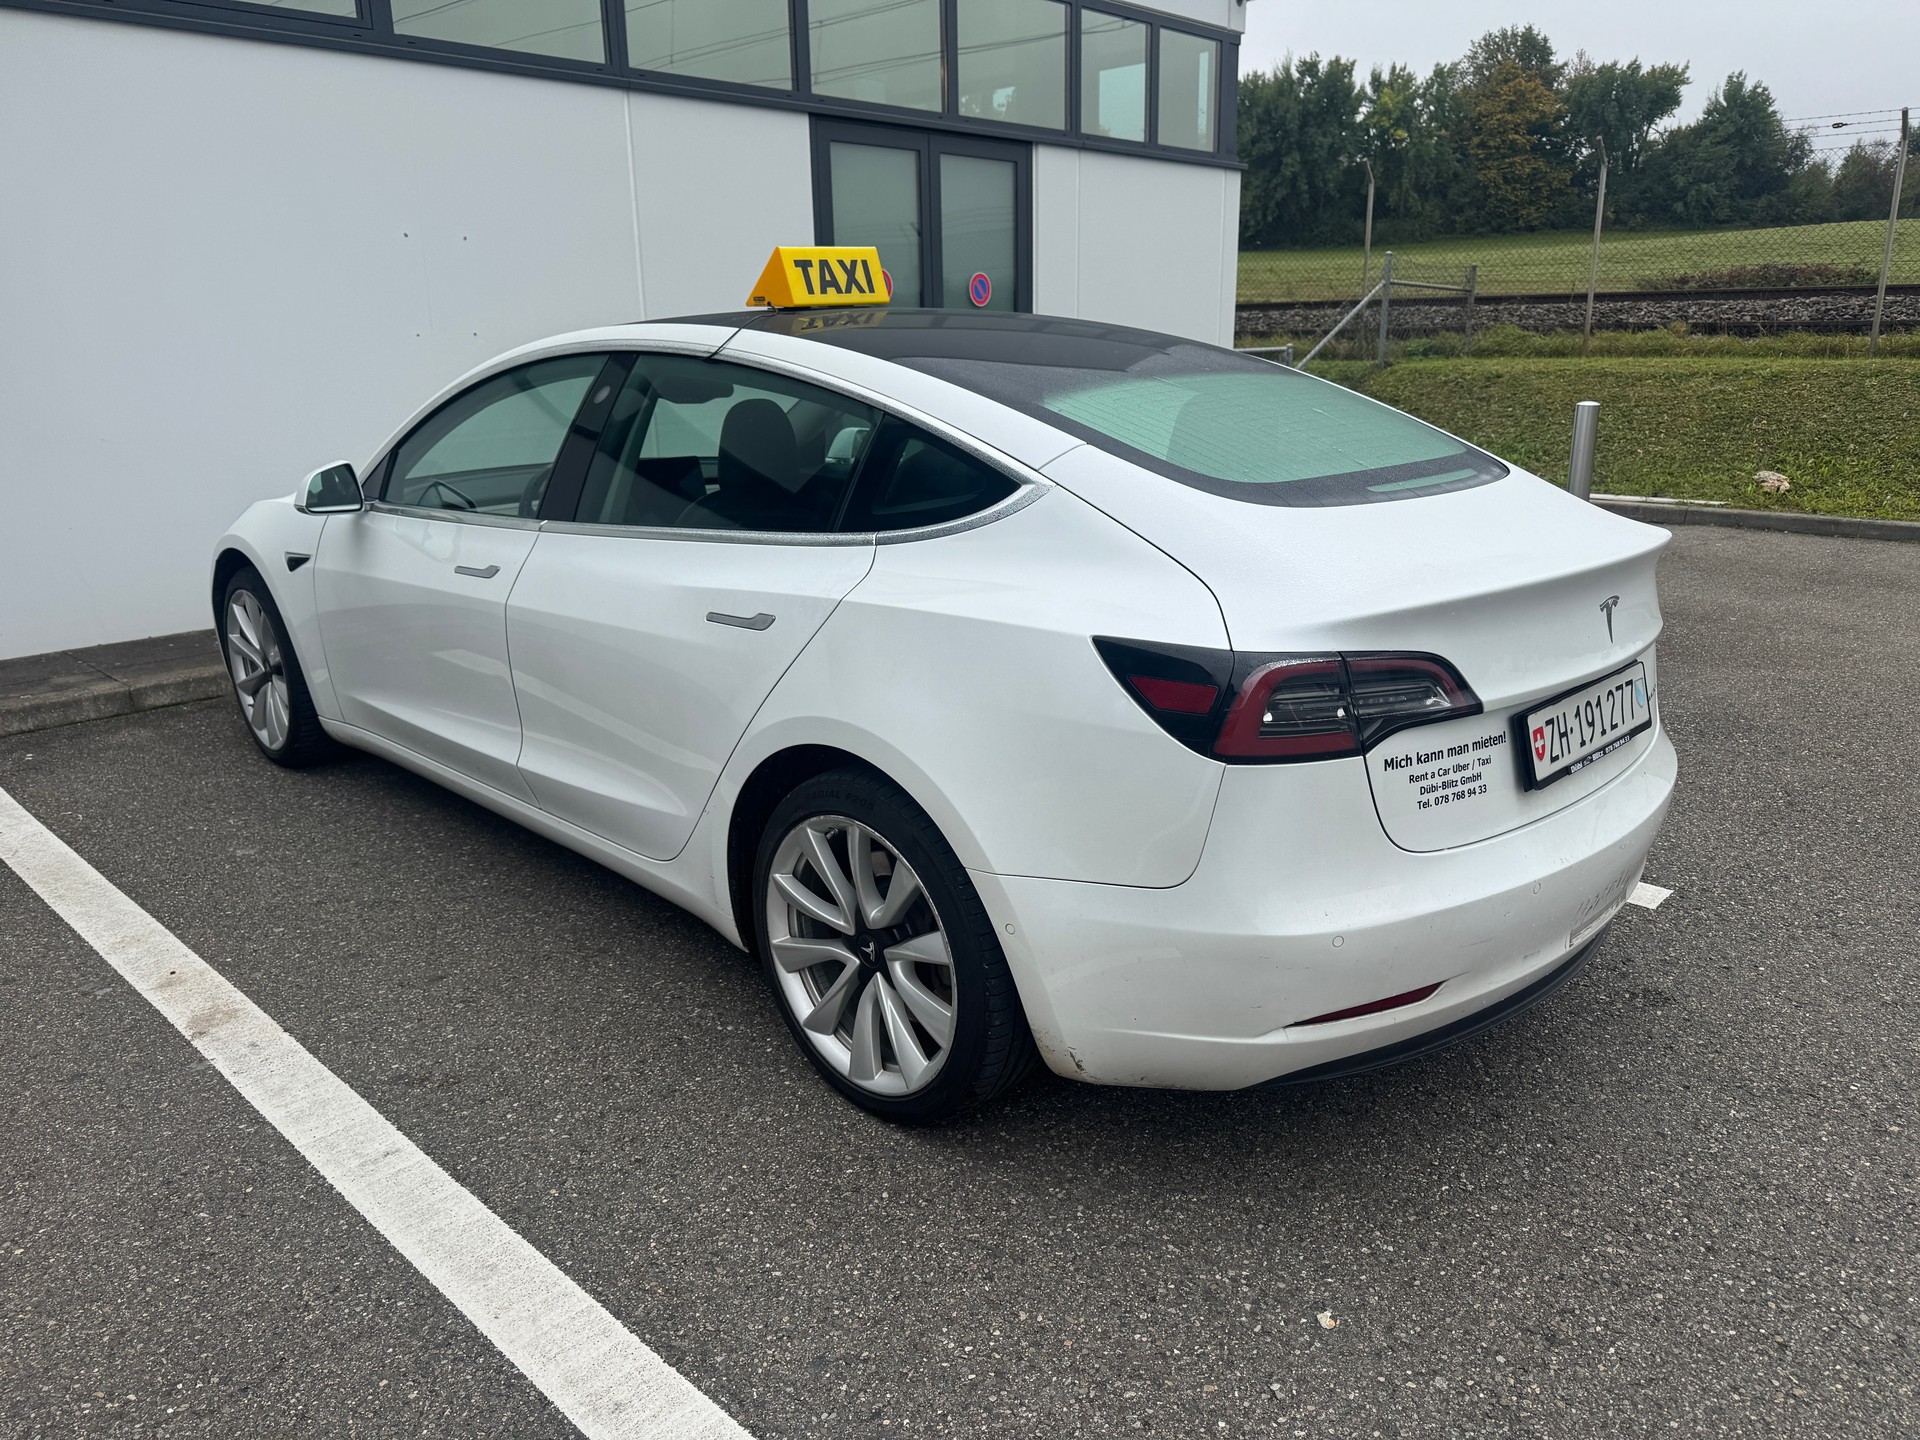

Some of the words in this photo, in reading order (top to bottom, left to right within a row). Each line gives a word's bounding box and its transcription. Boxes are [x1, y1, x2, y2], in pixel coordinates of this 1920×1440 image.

[793, 259, 875, 295] TAXI
[1384, 754, 1413, 772] Mich
[1416, 749, 1444, 765] kann
[1447, 743, 1469, 758] man
[1472, 731, 1507, 752] mieten!
[1409, 771, 1429, 784] Rent
[1430, 771, 1436, 779] a
[1437, 767, 1451, 777] Car
[1452, 761, 1470, 774] Uber
[1477, 755, 1492, 768] Taxi
[1419, 777, 1459, 796] Dübi-Blitz
[1460, 772, 1482, 785] GmbH
[1417, 799, 1433, 810] Tel.
[1434, 793, 1449, 806] 078
[1451, 790, 1466, 802] 768
[1467, 787, 1477, 797] 94
[1478, 784, 1487, 794] 33
